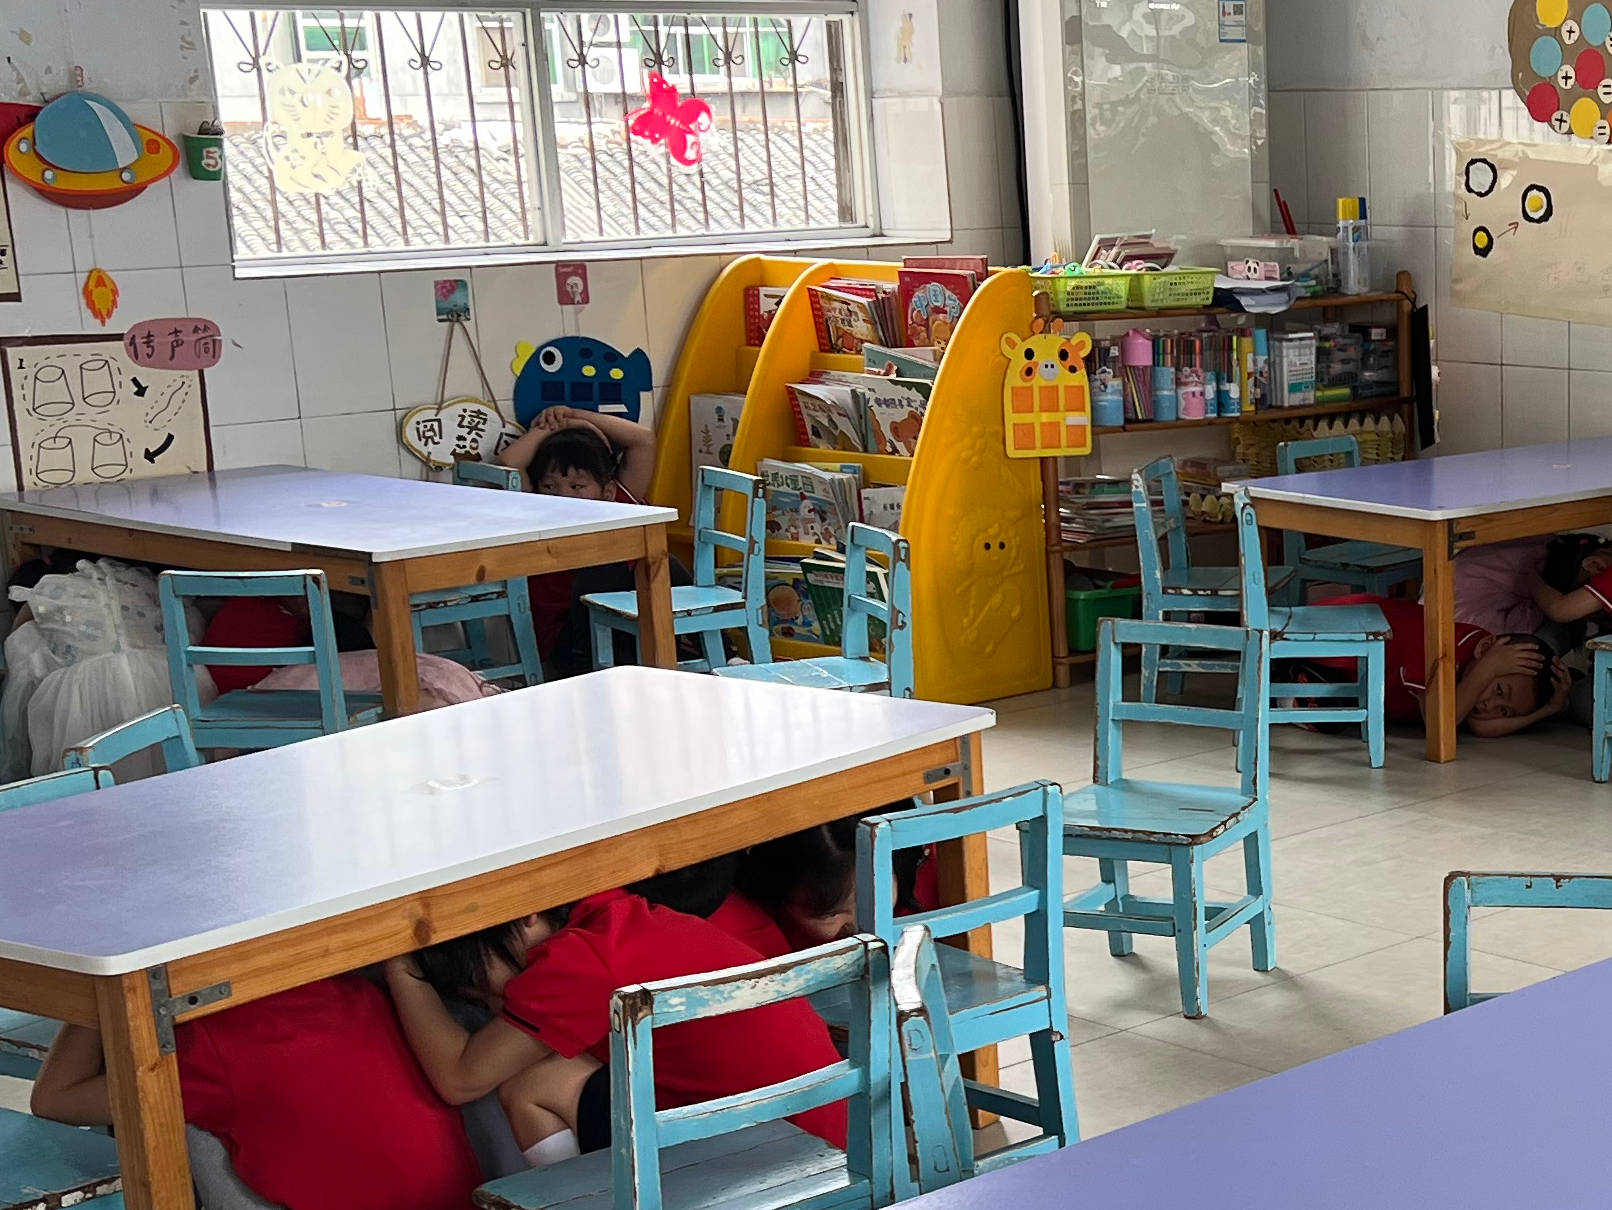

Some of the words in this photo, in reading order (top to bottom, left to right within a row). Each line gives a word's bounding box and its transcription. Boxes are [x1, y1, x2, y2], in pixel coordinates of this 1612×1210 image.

[204, 148, 220, 170] 5
[129, 324, 216, 361] 传声筒
